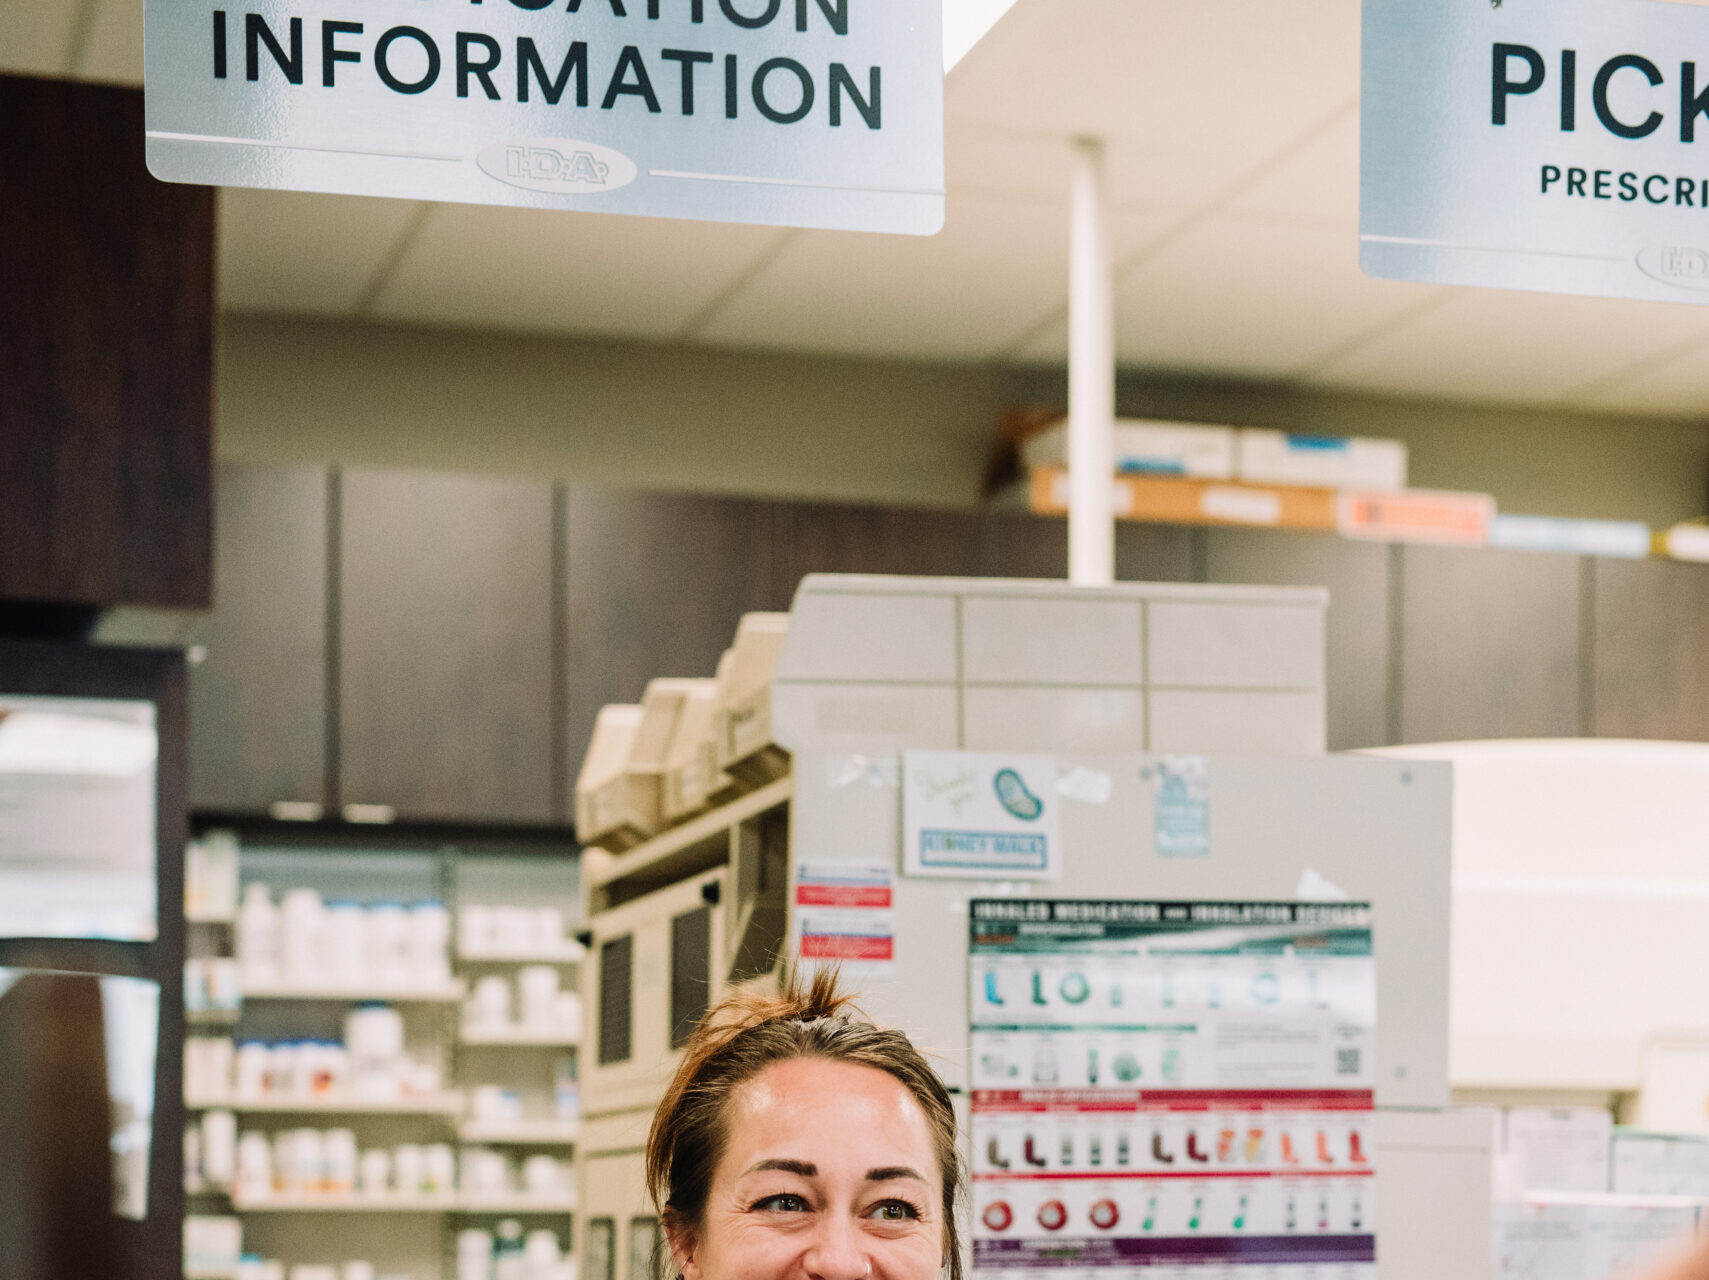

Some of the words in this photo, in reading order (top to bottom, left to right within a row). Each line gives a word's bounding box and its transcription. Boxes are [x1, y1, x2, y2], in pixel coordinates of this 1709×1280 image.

[212, 10, 881, 130] INFORMATION
[1541, 165, 1709, 208] PRESCRI
[1054, 903, 1159, 921] MEDICATION
